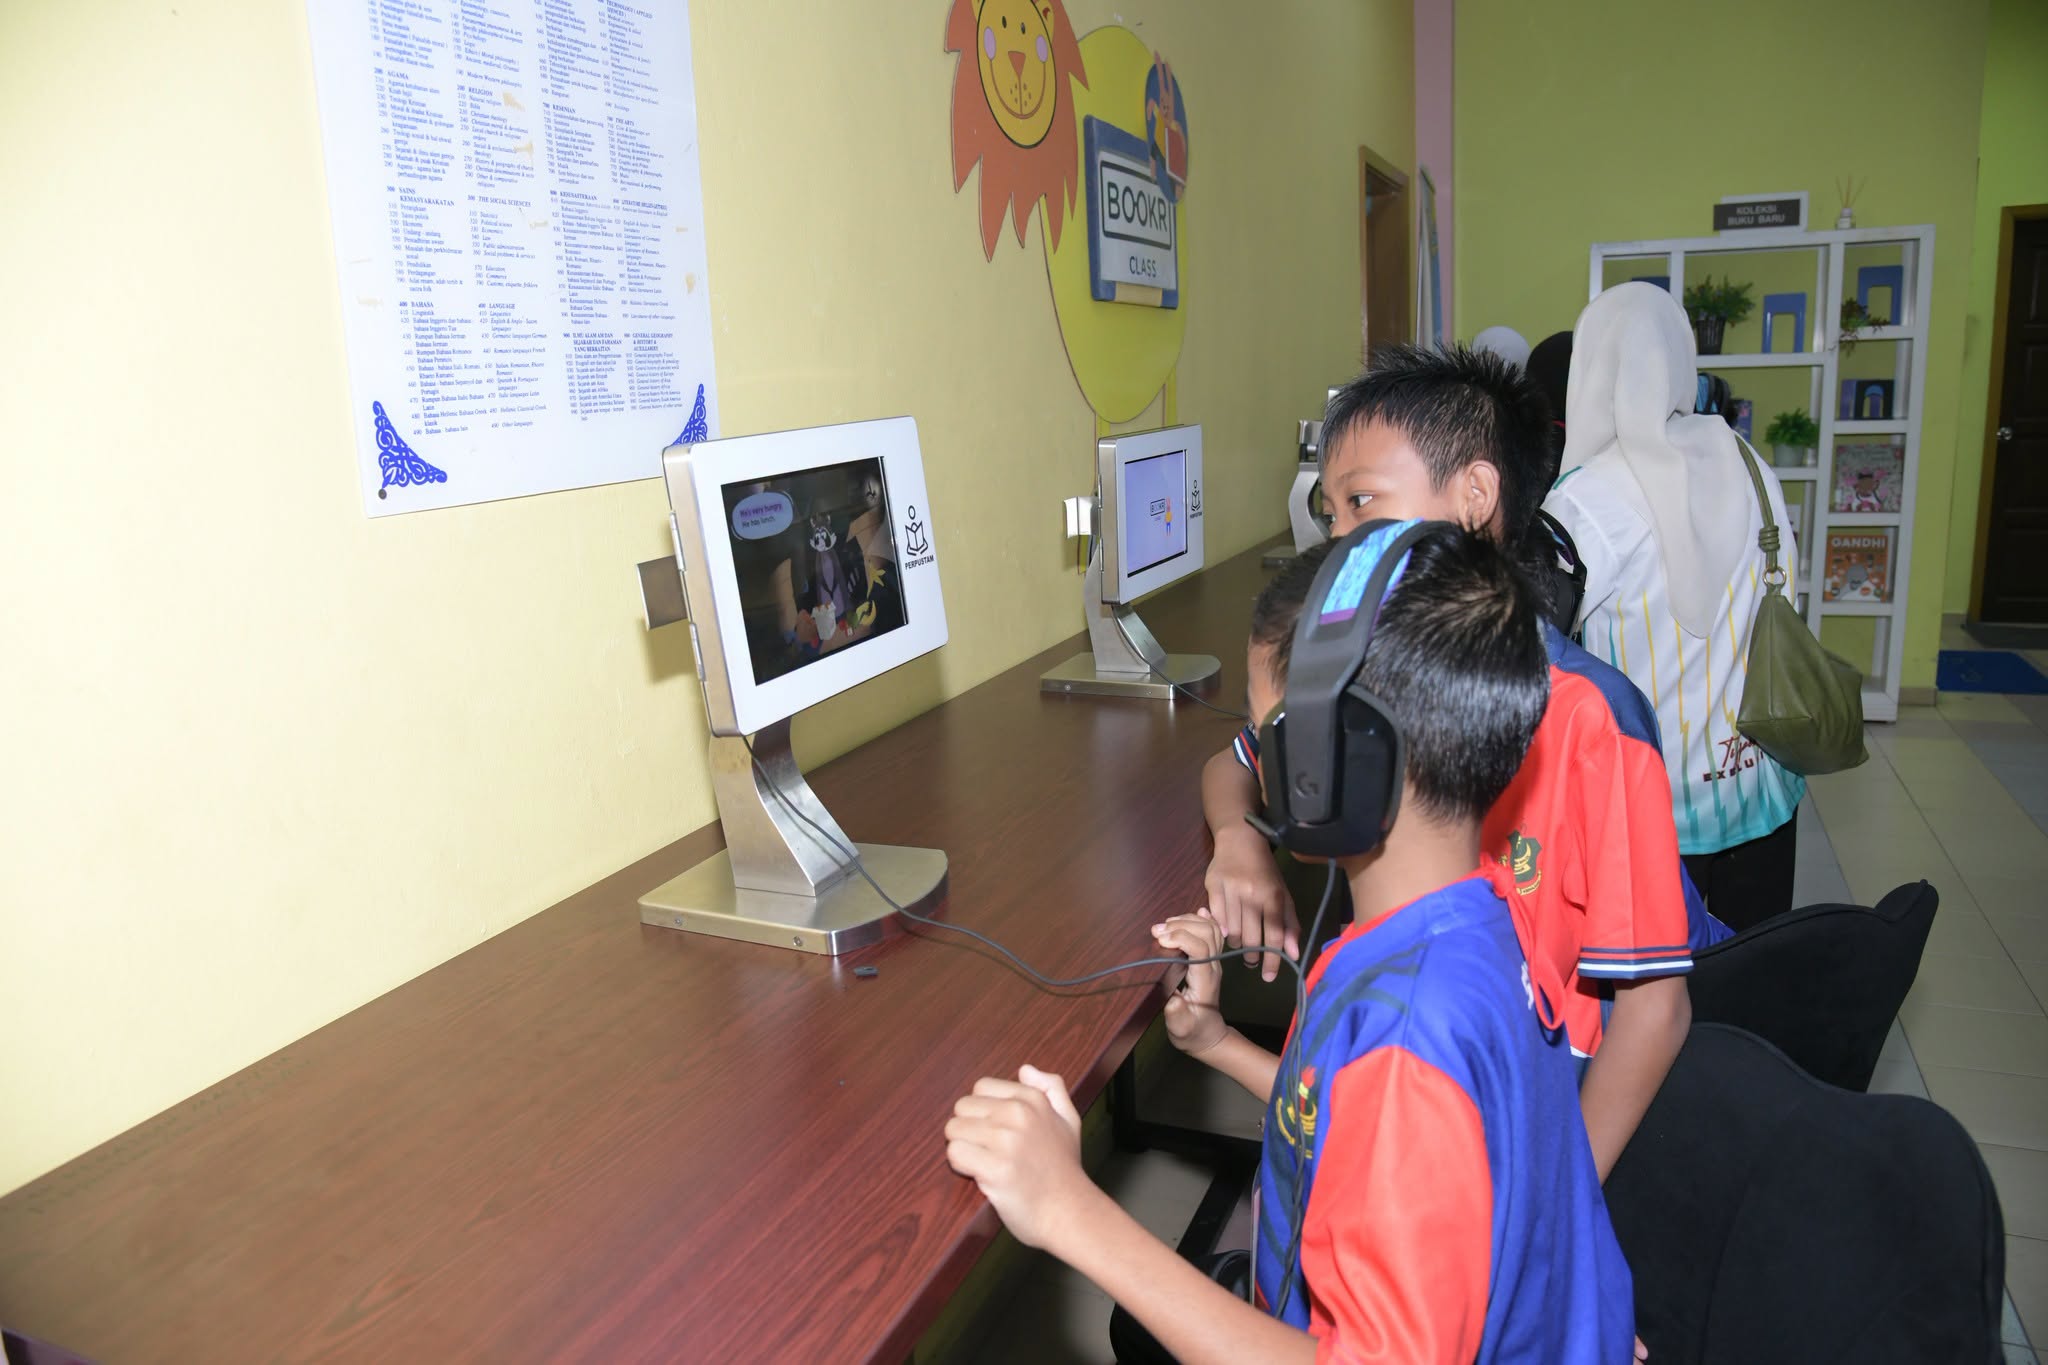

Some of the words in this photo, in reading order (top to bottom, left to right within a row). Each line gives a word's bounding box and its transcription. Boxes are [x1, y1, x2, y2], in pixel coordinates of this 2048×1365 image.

[469, 87, 493, 96] RELIGION
[400, 196, 454, 206] KEMASYARAKATAN
[1108, 182, 1168, 232] BOOKR
[1736, 206, 1777, 216] KOLEKSI
[1728, 216, 1754, 226] BUKU
[1758, 214, 1786, 224] BARU
[1129, 256, 1157, 278] CLASS
[1832, 537, 1886, 548] GANDHI
[905, 555, 934, 570] PERPUSTAM
